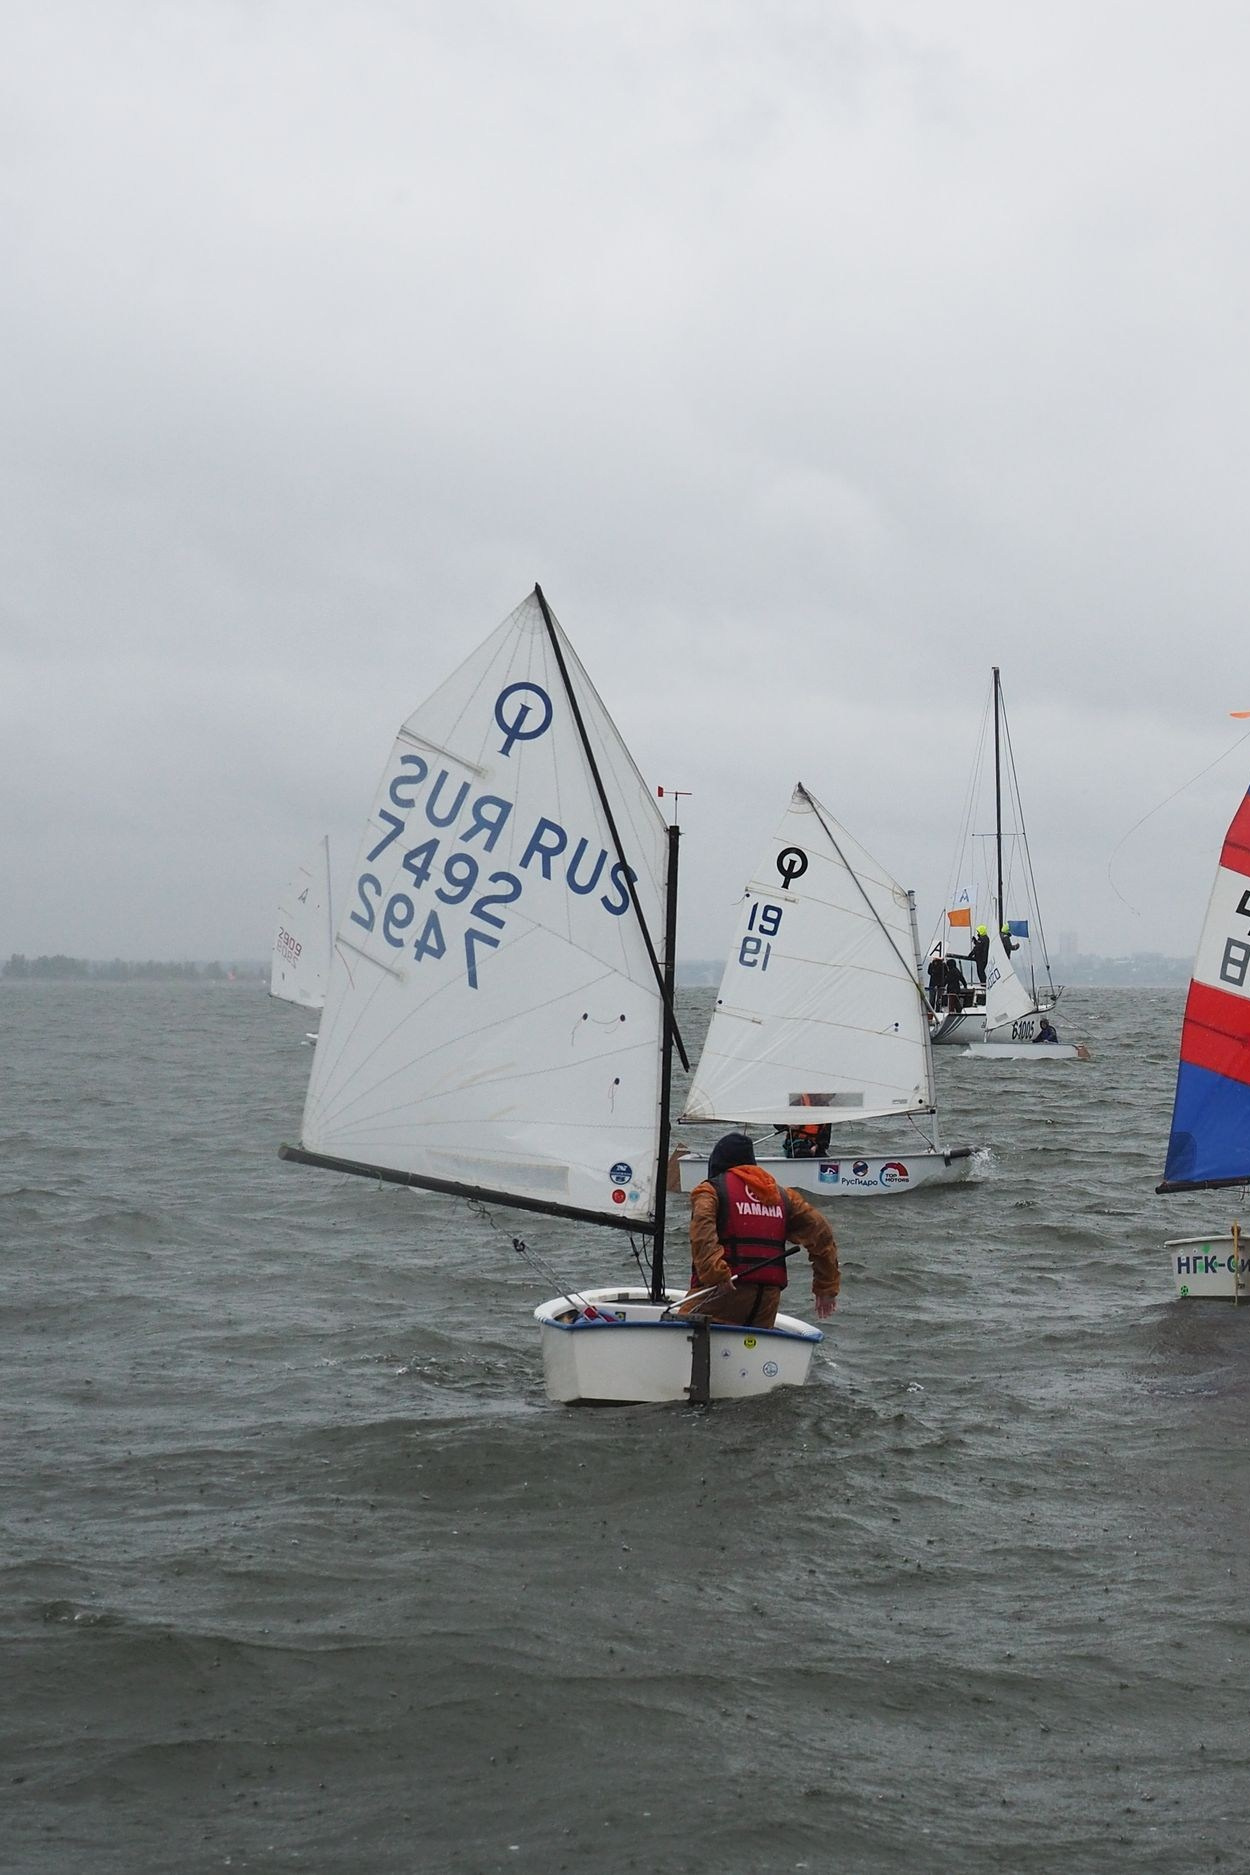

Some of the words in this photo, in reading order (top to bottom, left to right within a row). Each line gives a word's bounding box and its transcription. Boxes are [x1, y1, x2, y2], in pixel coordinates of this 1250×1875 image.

[366, 809, 522, 929] 7492
[518, 817, 638, 916] RUS
[747, 902, 783, 936] 19
[278, 926, 302, 956] 2909
[841, 1177, 878, 1186] РусГидро
[735, 1202, 783, 1219] YAMAHA
